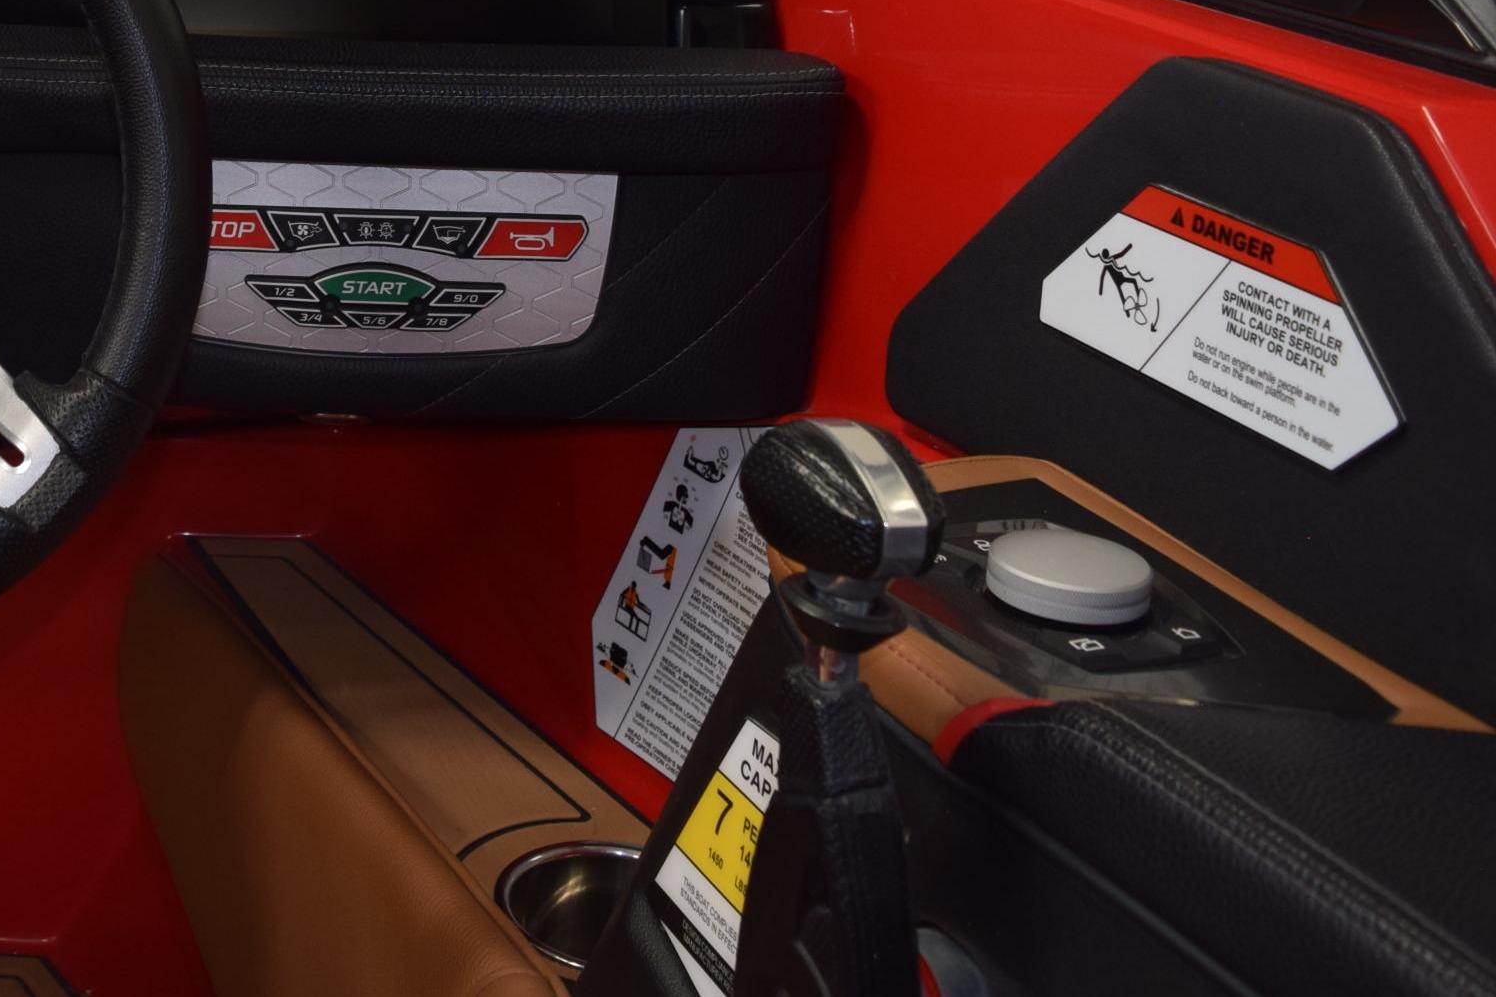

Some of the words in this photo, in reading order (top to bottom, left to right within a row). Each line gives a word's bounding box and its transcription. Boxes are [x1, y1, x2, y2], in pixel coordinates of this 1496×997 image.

[210, 220, 256, 239] TOP
[1192, 213, 1275, 265] DANGER
[274, 287, 295, 297] 1/2
[340, 281, 407, 296] START
[453, 293, 479, 304] 9/0
[1238, 281, 1290, 312] CONTACT
[1292, 304, 1321, 327] WITH
[1322, 318, 1332, 332] A
[299, 312, 322, 323] 3/4
[362, 315, 386, 325] 5/6
[425, 317, 448, 327] 7/8
[1221, 303, 1246, 326] WILL
[1248, 317, 1287, 343] CAUSE
[1288, 334, 1339, 367] SERIOUS
[1223, 289, 1273, 322] SPINNING
[1275, 312, 1343, 353] PROPELLER
[1194, 336, 1205, 350] Do
[1206, 344, 1218, 357] not
[1219, 350, 1231, 363] run
[1232, 356, 1256, 375] engine
[1226, 320, 1265, 349] INJURY
[1266, 340, 1284, 358] OR
[1285, 348, 1326, 379] DEATH.
[1193, 350, 1212, 365] water
[1212, 359, 1221, 370] or
[1221, 363, 1231, 375] on
[1232, 366, 1244, 382] the
[1245, 375, 1265, 392] swim
[1187, 370, 1199, 384] Do
[1199, 378, 1211, 391] not
[1211, 381, 1228, 400] back
[1230, 391, 1255, 412] toward
[1256, 406, 1262, 416] a
[1262, 410, 1288, 429] person
[1298, 425, 1311, 441] the
[752, 738, 778, 778] MA
[740, 760, 772, 797] CAP
[716, 788, 734, 836] 7
[742, 816, 758, 845] PE
